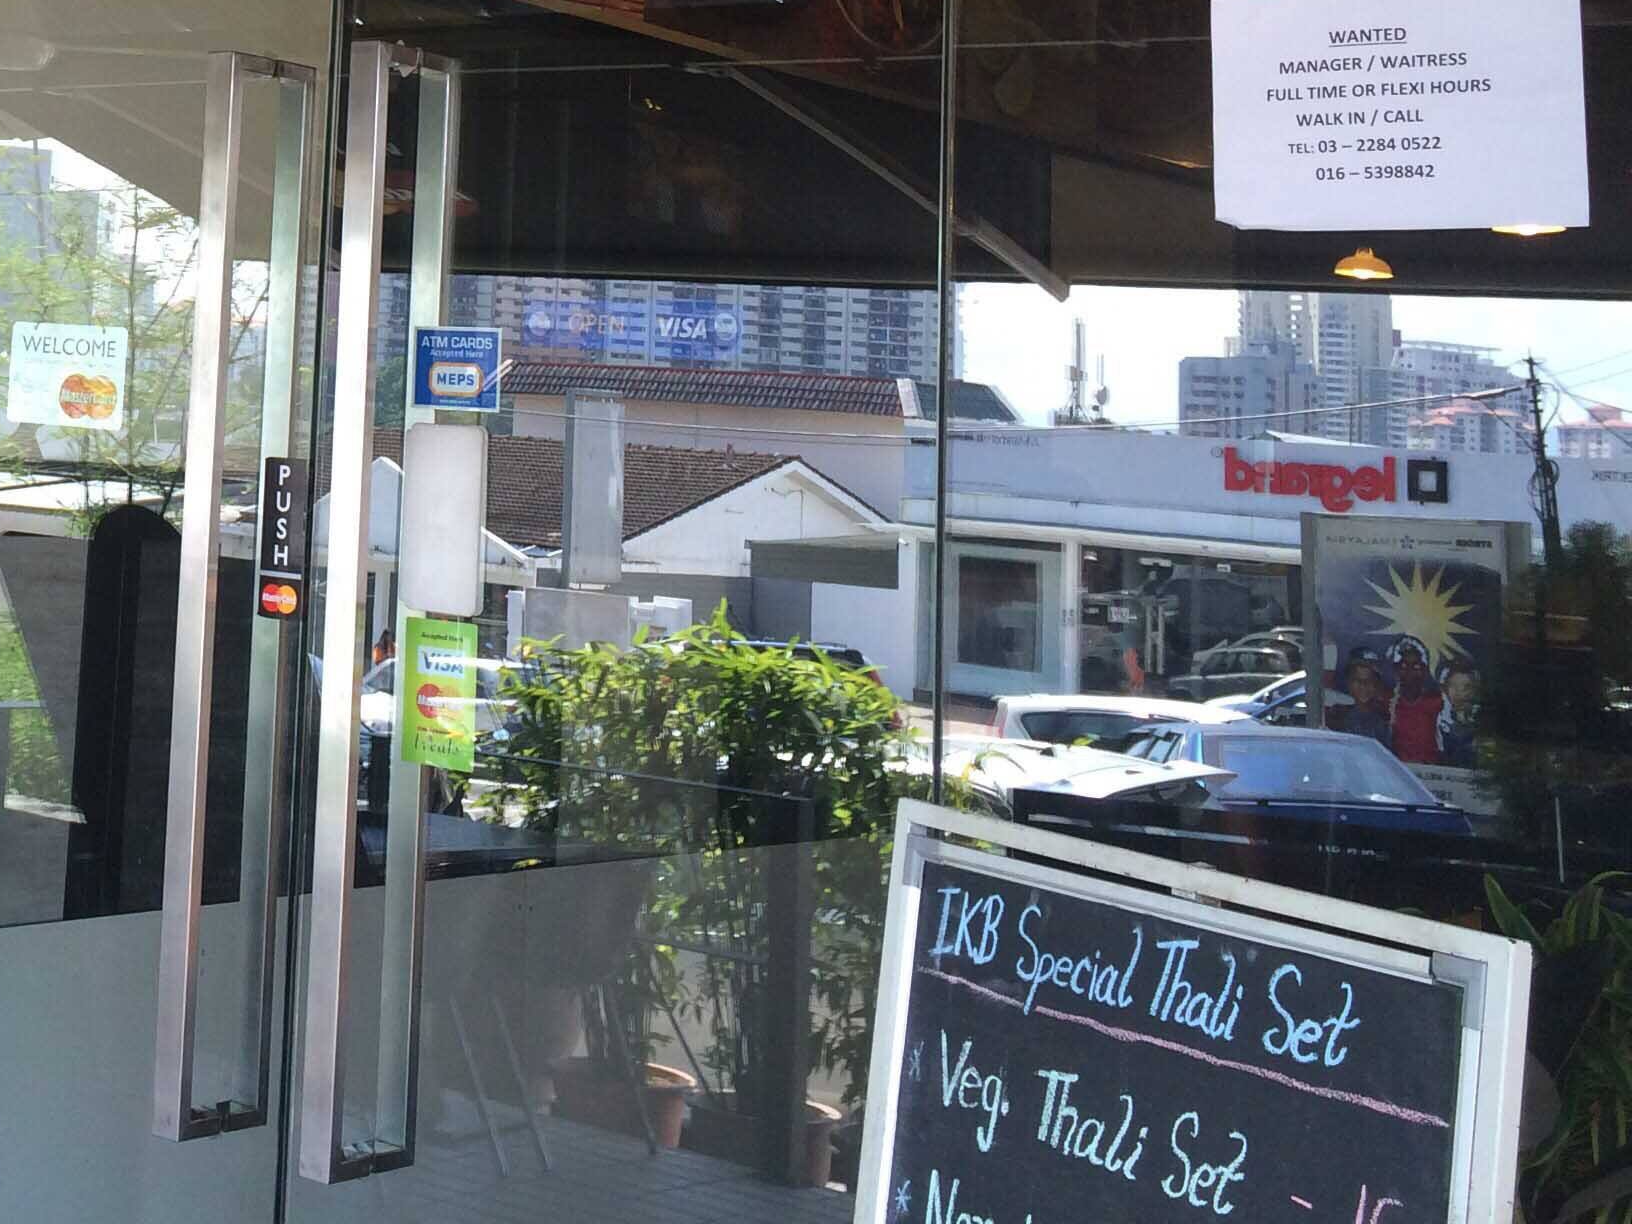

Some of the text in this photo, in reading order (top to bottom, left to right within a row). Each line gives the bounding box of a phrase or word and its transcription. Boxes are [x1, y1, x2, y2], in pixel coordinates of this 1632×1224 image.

[1329, 27, 1407, 45] WANTED
[1279, 57, 1362, 75] MANAGER
[1380, 52, 1467, 69] WAITRESS
[1266, 78, 1491, 102] FULL TIME OR FLEXI HOURS
[1296, 112, 1343, 127] WALK
[1348, 111, 1365, 125] IN
[1384, 109, 1424, 124] CALL
[1288, 143, 1314, 154] TEL:
[1318, 139, 1338, 153] 03
[1356, 138, 1396, 152] 2284
[1401, 136, 1442, 151] 0522
[1316, 167, 1345, 181] 016
[1364, 165, 1435, 180] 5398842
[658, 316, 708, 339] VISA
[23, 334, 117, 359] WELCOME
[421, 336, 493, 349] ATM CARDS
[436, 373, 474, 386] MEPS
[272, 464, 291, 567] PUSH
[928, 887, 1362, 1068] IKB Special Thali Set
[940, 1029, 1010, 1152] Veg.
[1037, 1069, 1150, 1180] Thali
[1161, 1111, 1247, 1216] Set
